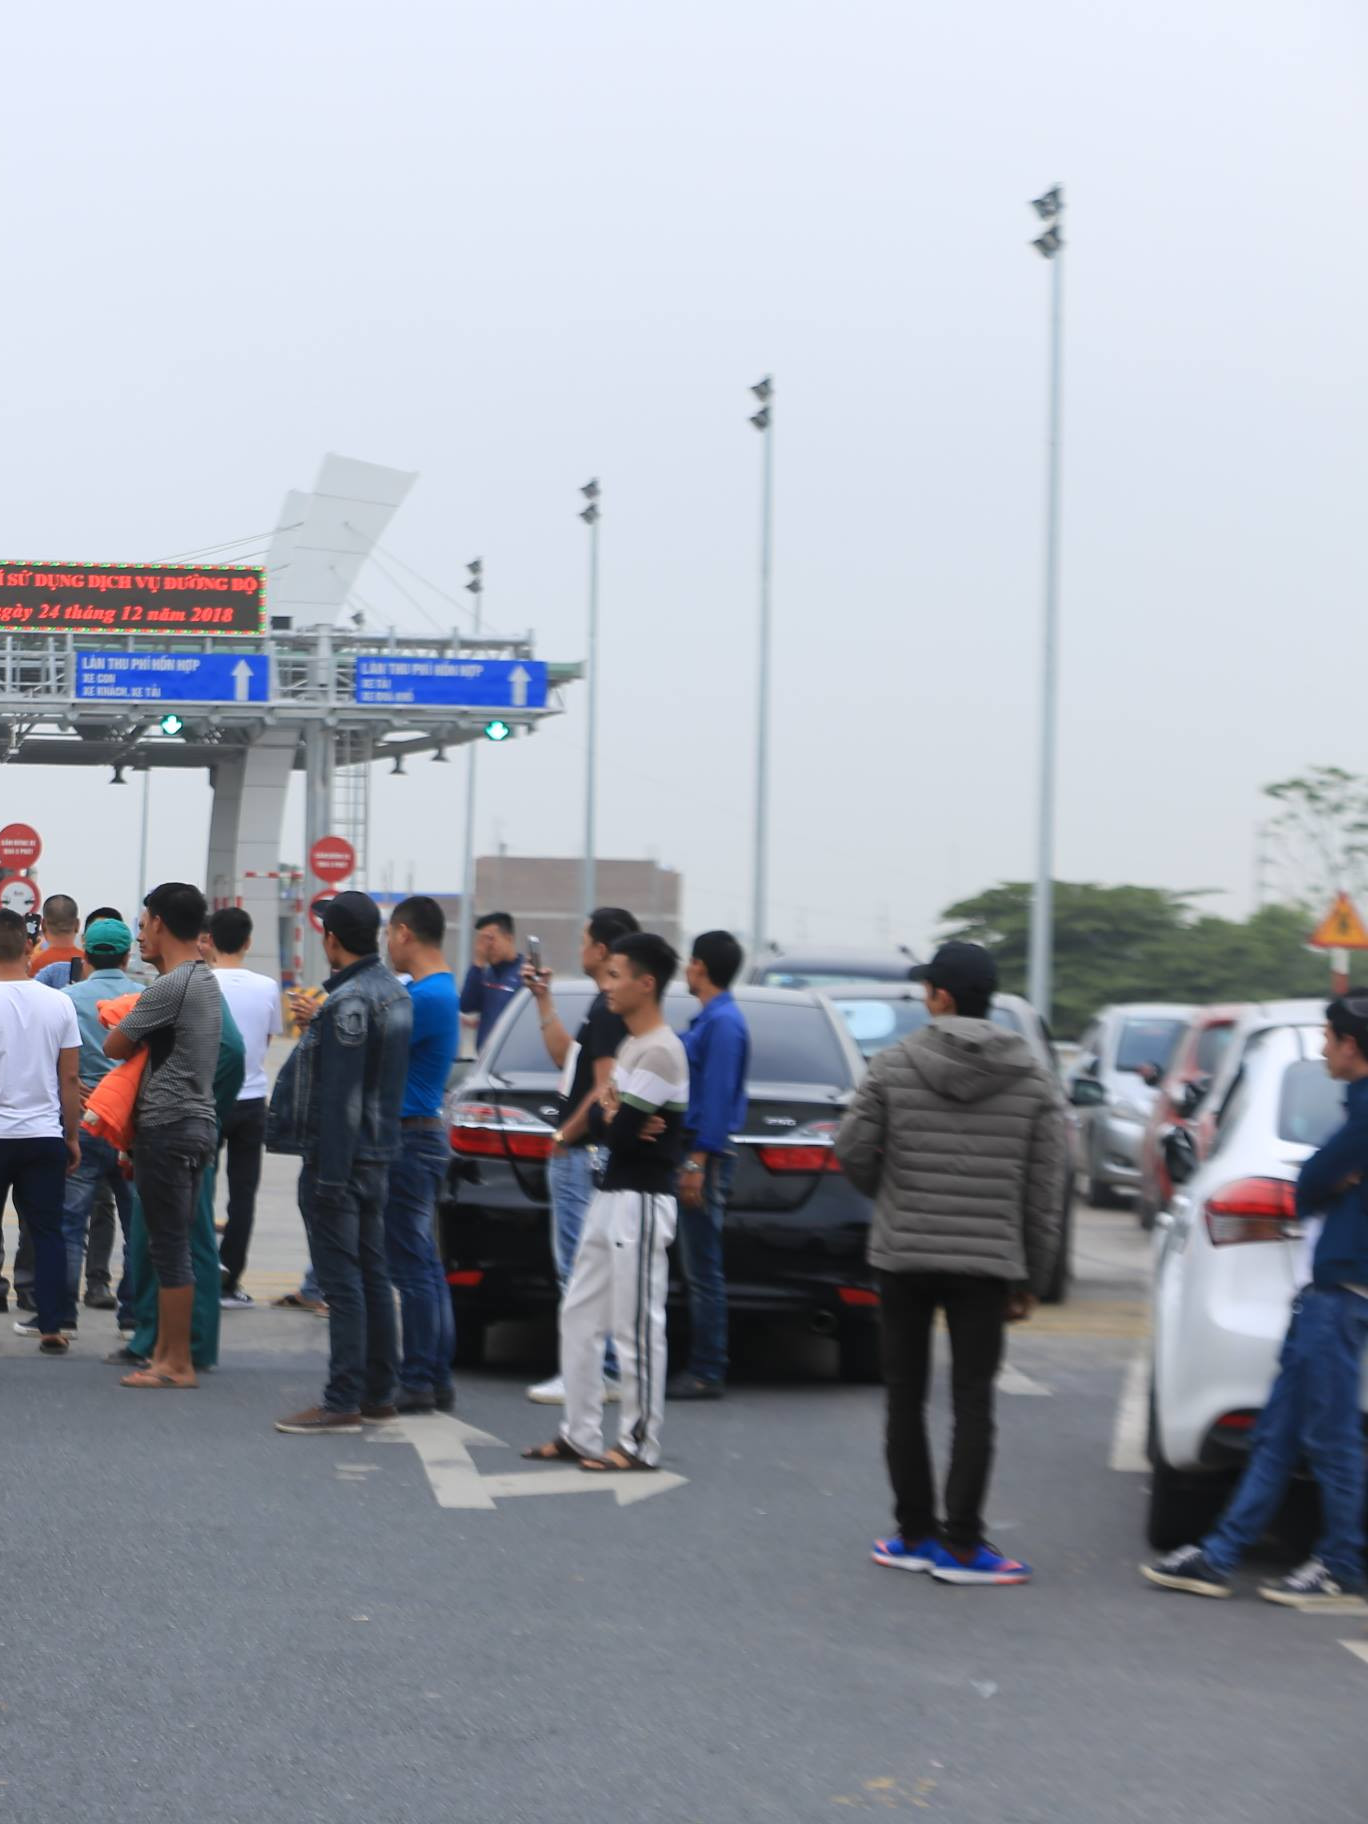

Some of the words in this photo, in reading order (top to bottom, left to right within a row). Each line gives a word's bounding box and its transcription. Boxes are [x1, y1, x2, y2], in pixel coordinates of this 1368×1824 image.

[34, 573, 85, 591] DỤNG
[88, 574, 132, 592] DỊCH
[136, 575, 161, 593] VỤ
[38, 604, 60, 619] 24
[64, 604, 116, 624] tháng
[121, 606, 142, 621] 12
[146, 607, 186, 622] năm
[190, 607, 234, 622] 2018
[108, 658, 129, 670] THU
